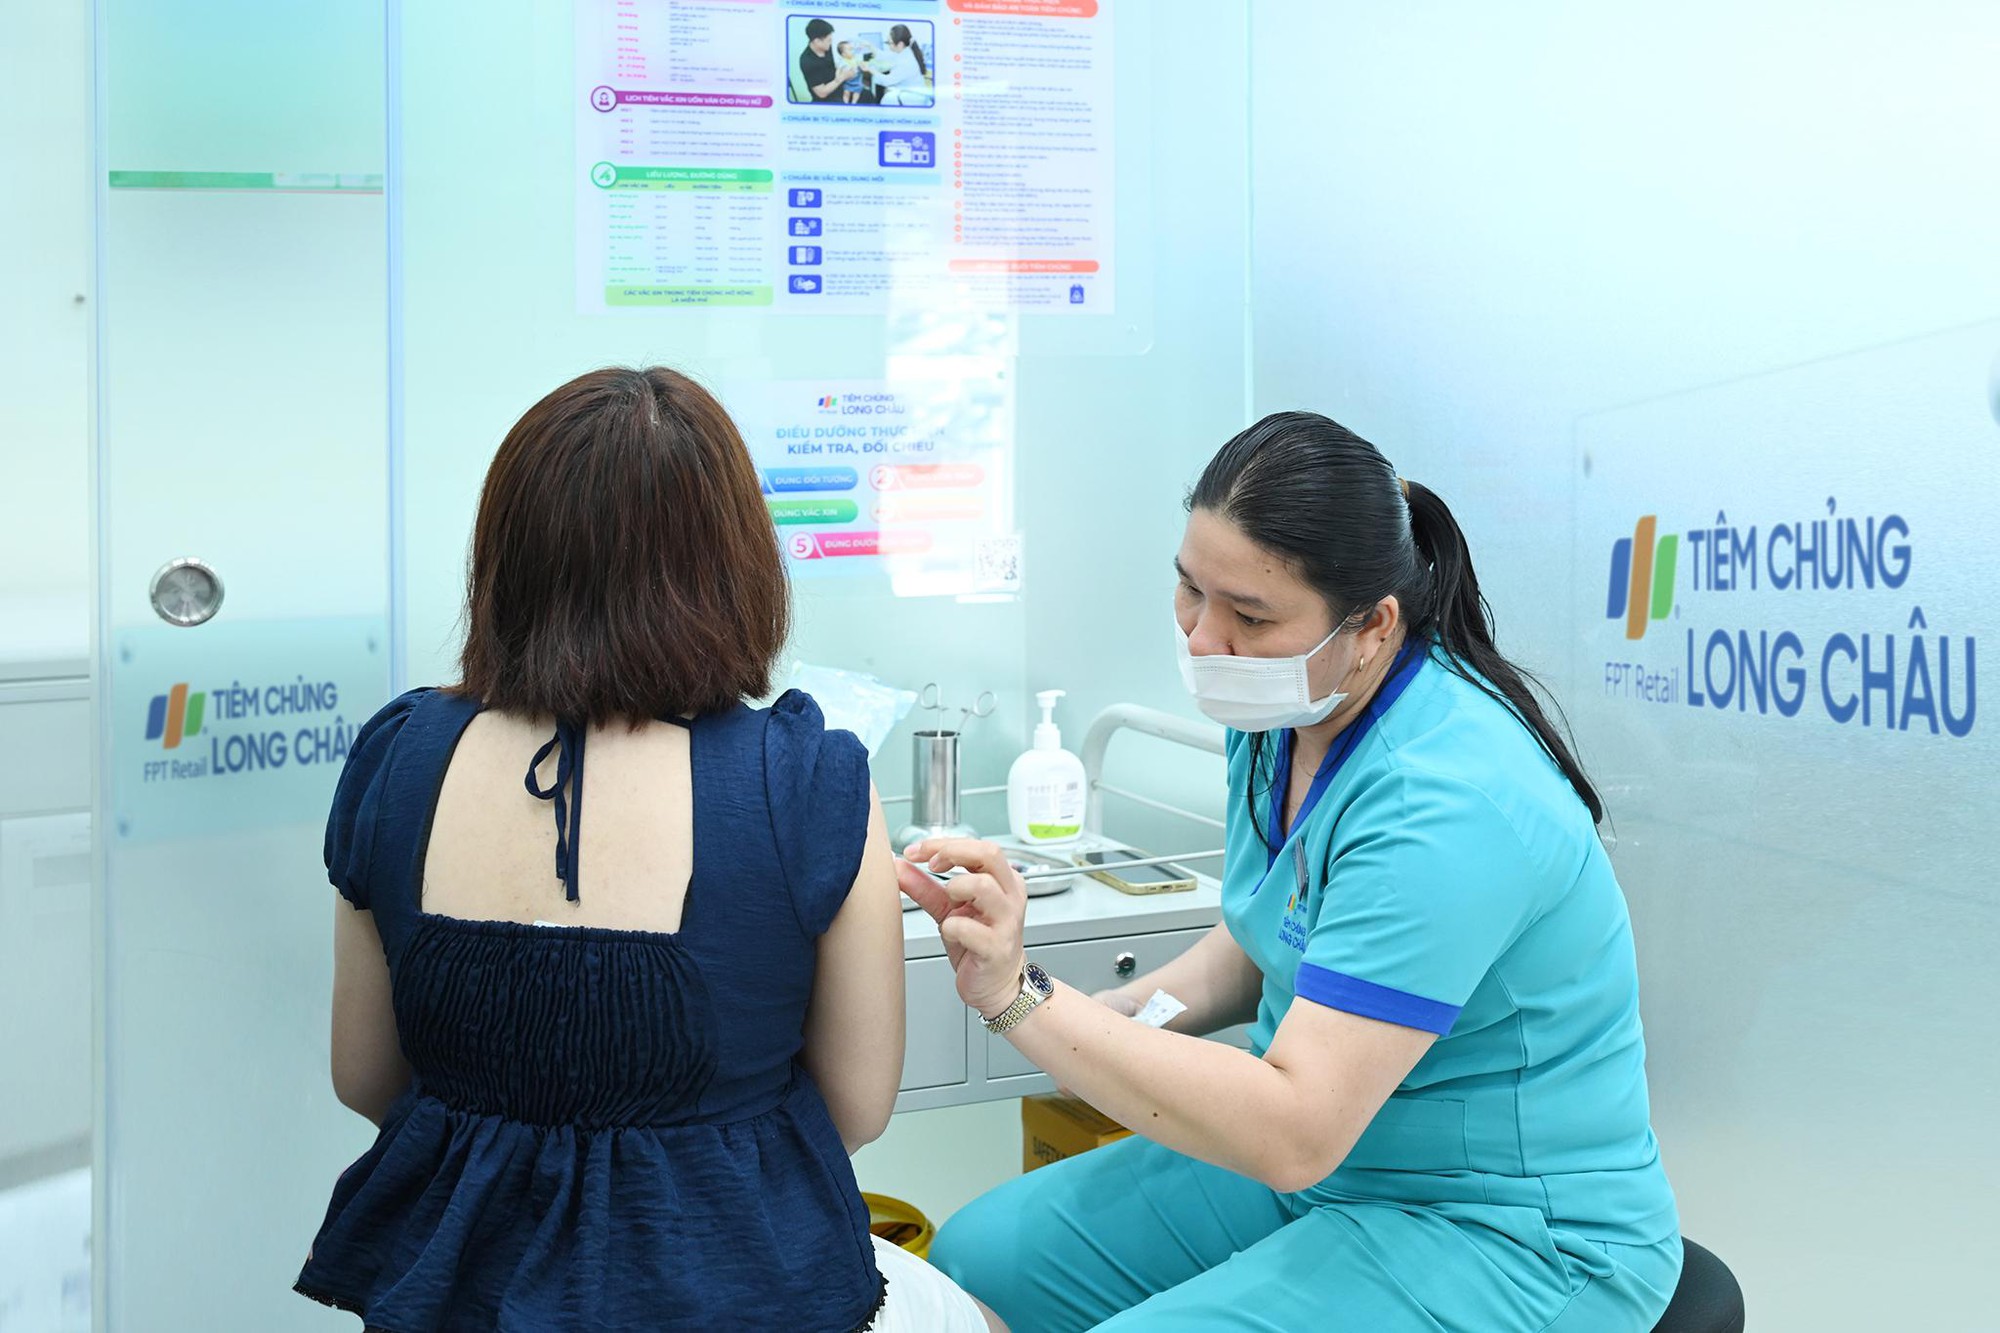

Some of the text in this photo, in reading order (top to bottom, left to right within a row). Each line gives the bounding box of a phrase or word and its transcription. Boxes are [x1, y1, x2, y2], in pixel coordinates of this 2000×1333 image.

[842, 393, 895, 403] TIÊM CHỦNG
[842, 405, 872, 415] LONG
[827, 443, 859, 455] TRA,
[863, 439, 888, 453] ĐỐI
[796, 538, 807, 553] 5
[1686, 495, 1912, 592] TIÊM CHỦNG
[1605, 662, 1680, 704] FPT Retail
[1686, 605, 1976, 738] LONG CHÂU
[212, 674, 338, 720] TIÊM CHỦNG
[143, 756, 208, 784] FPT Retail
[211, 730, 288, 775] LONG
